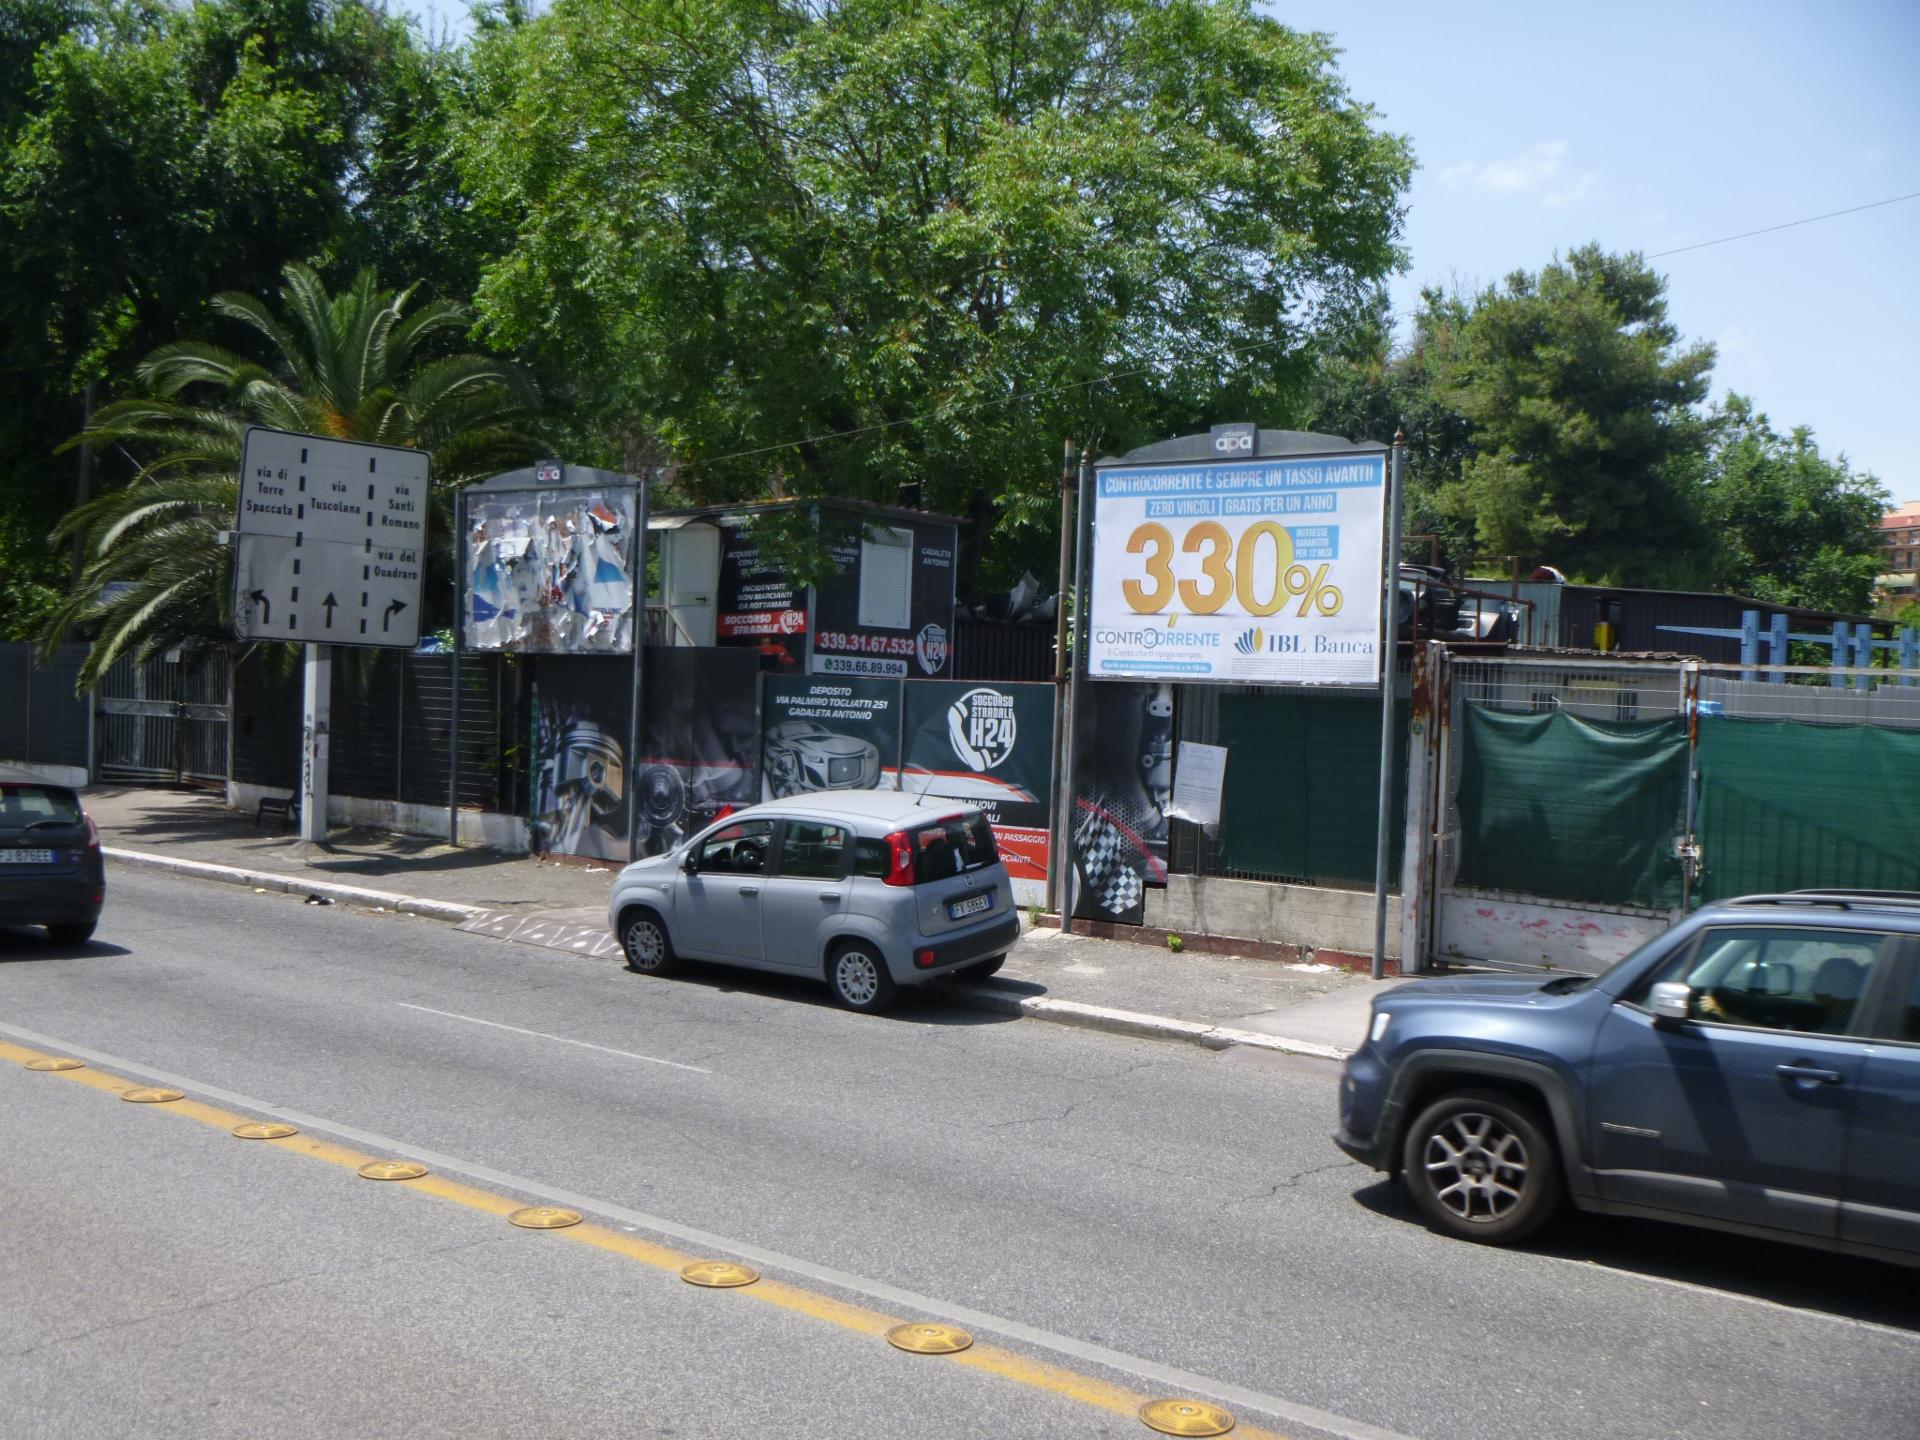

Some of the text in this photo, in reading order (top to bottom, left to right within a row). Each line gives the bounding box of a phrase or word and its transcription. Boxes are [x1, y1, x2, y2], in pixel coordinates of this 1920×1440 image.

[257, 466, 288, 480] via di
[1105, 474, 1203, 493] CONTROCORRENTE
[1216, 470, 1263, 489] SEMPRE
[1266, 469, 1282, 487] UN
[1286, 466, 1322, 485] TASSO
[1325, 464, 1373, 484] AVANTI!
[258, 482, 285, 496] Torre
[332, 480, 347, 493] via
[395, 483, 410, 496] via
[246, 500, 293, 516] Spaccata
[311, 497, 360, 515] Tuscolana
[388, 499, 415, 512] Santi
[1150, 495, 1333, 516] ZERO VINCOLI GRATIS PER UN ANNO
[382, 515, 420, 530] Romano
[378, 549, 416, 563] via del
[725, 614, 771, 624] SOCCORSO
[786, 612, 804, 626] H24
[733, 624, 779, 635] STRADALE
[820, 632, 914, 655] 339.31.67.532
[1269, 635, 1374, 654] IBL Banca
[833, 660, 903, 674] 339.66.89.994
[810, 686, 852, 696] DEPOSITO
[776, 696, 888, 709] VIA PALMIRO TOGLIATTI 251
[972, 694, 1014, 707] SOCCORSO
[832, 710, 872, 720] ANTONIO
[972, 707, 1013, 718] STRADALE
[970, 718, 1012, 748] H24
[1004, 833, 1046, 844] PASSAGGIO
